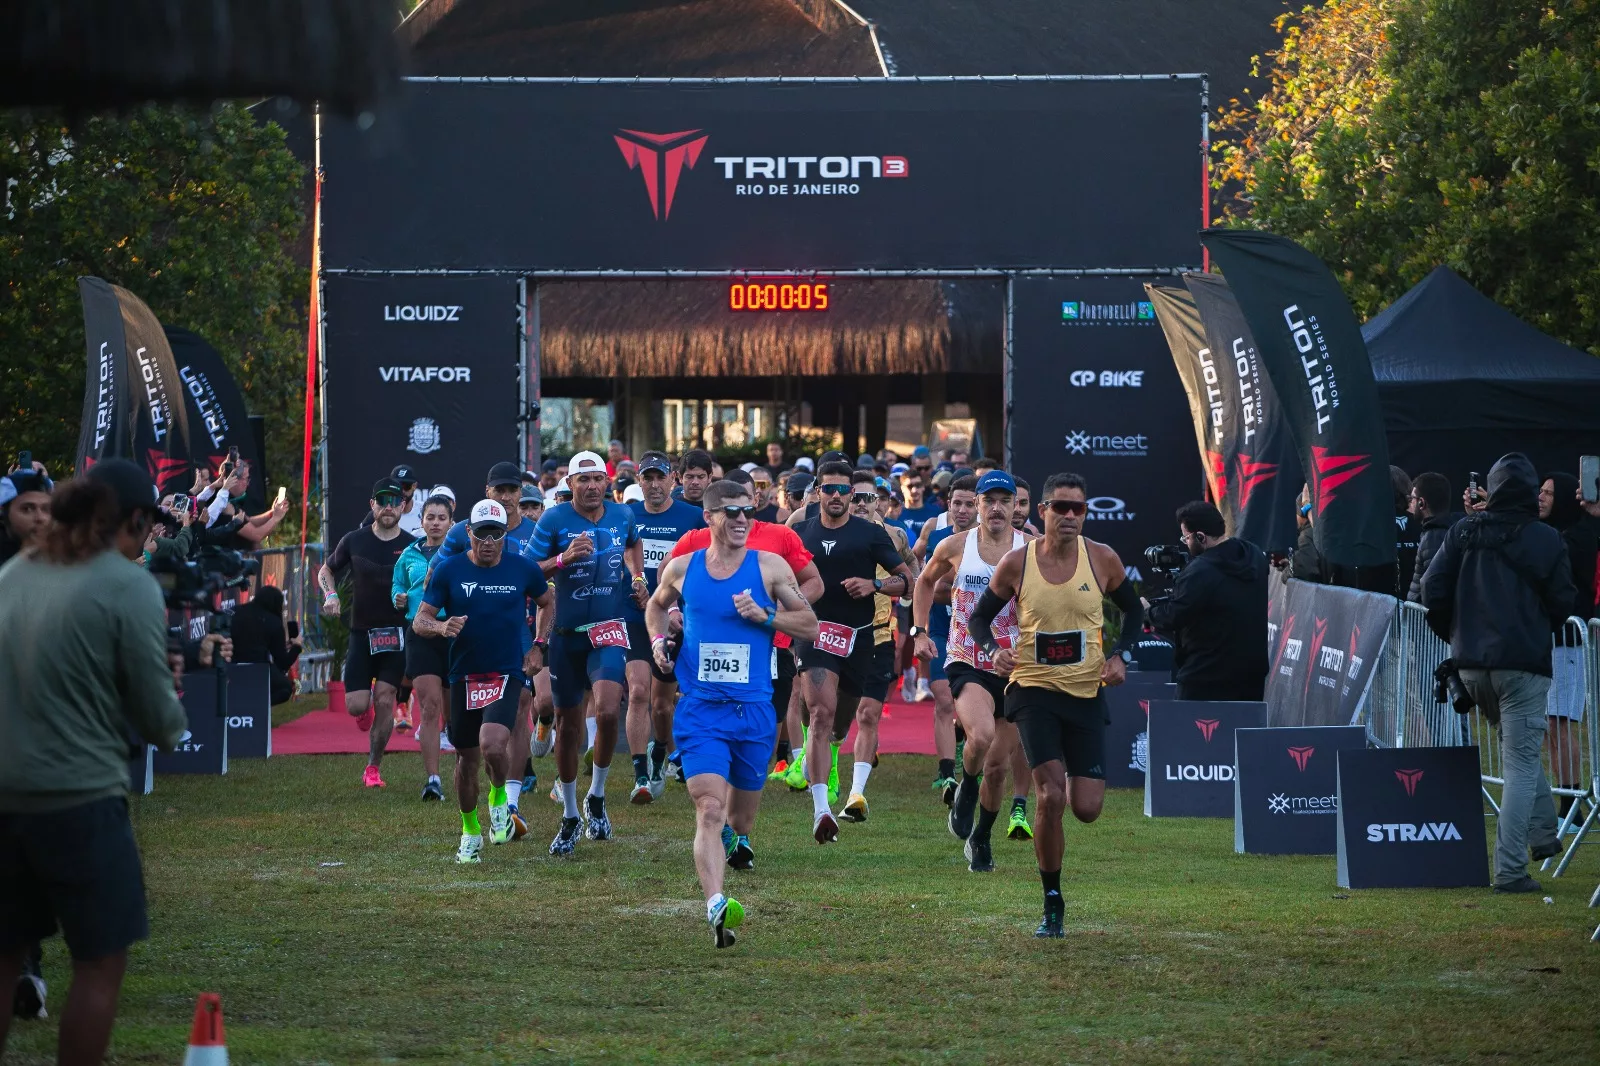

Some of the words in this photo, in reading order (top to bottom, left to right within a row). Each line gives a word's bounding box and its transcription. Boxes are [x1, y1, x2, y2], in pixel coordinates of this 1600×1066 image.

[736, 184, 763, 195] RIO
[769, 184, 788, 195] DE
[793, 184, 859, 195] JANEIRO
[731, 284, 829, 310] 00:00:05
[1080, 301, 1136, 319] PORTOBELLO
[384, 305, 460, 321] LIQUIDZ
[1308, 315, 1329, 360] SERIES
[151, 357, 163, 390] SERIES
[379, 366, 471, 382] VITAFOR
[1070, 370, 1096, 387] CP
[1099, 370, 1144, 387] BIKE
[1248, 347, 1261, 385] SERIES
[1283, 304, 1331, 434] TRITON
[94, 341, 108, 450] TRITON
[136, 346, 167, 443] TRITON
[198, 372, 216, 400] SERIES
[1198, 348, 1224, 446] TRITON
[1232, 337, 1256, 445] TRITON
[1327, 364, 1340, 408] WORLD
[161, 394, 172, 426] WORLD
[179, 365, 225, 449] TRITON
[215, 402, 229, 432] WORLD
[1253, 388, 1263, 425] WORLD
[1092, 433, 1148, 449] meet
[965, 574, 991, 586] GUIDO
[820, 631, 847, 649] 6023
[1047, 645, 1073, 659] 935
[703, 658, 740, 673] 3043
[470, 686, 500, 701] 6020
[1292, 794, 1338, 808] meet
[1366, 822, 1463, 842] STRAVA
